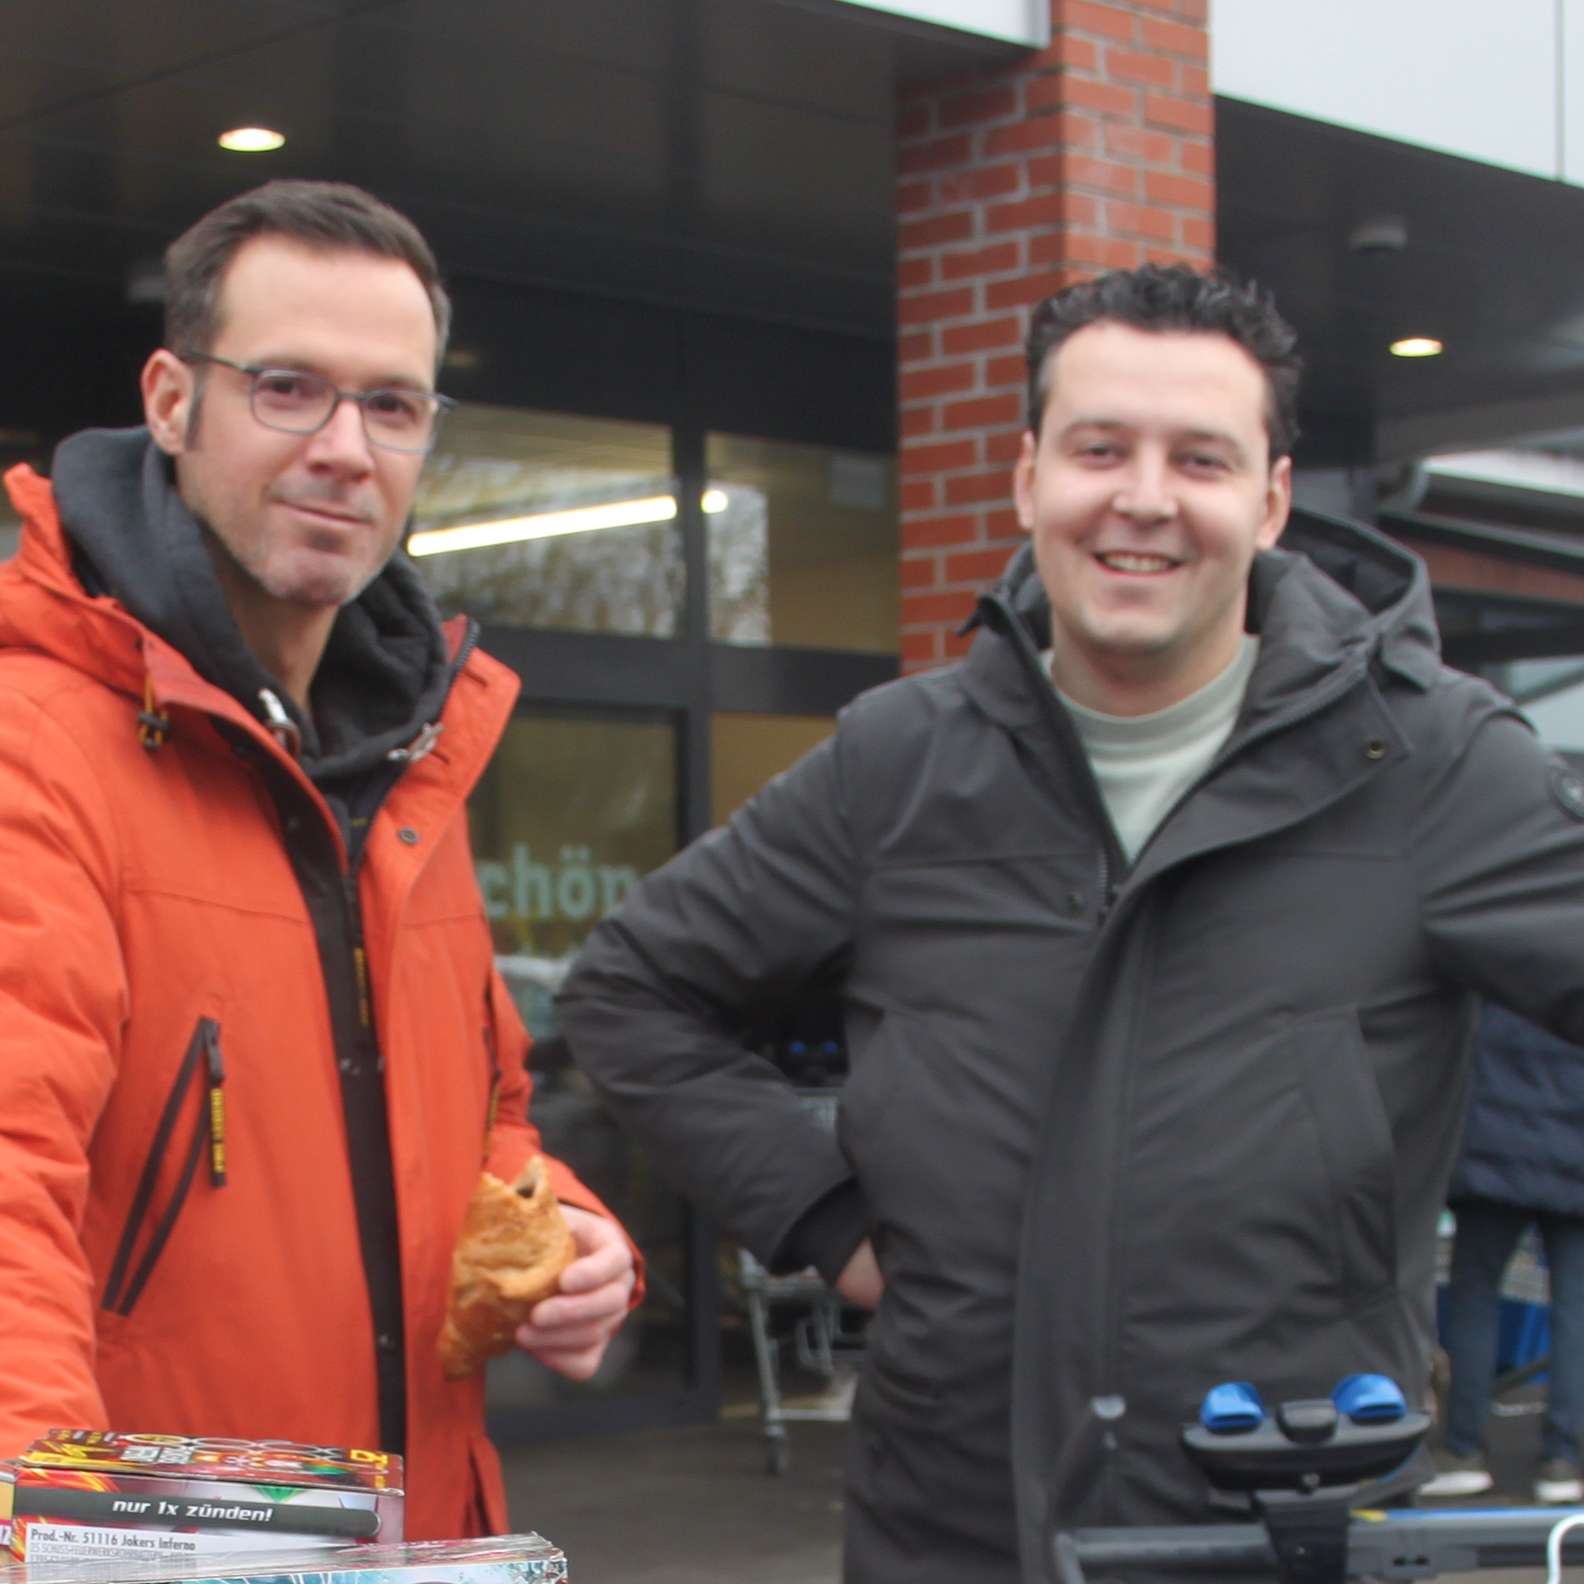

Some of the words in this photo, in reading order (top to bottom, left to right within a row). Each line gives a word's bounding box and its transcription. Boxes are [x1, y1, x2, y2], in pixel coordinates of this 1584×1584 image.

[479, 842, 638, 919] chön
[112, 1500, 150, 1516] nur
[157, 1500, 178, 1516] 1x
[185, 1503, 273, 1523] zünden!
[30, 1528, 78, 1542] Prod.-Nr.
[82, 1531, 118, 1544] 51116
[120, 1533, 156, 1548] Jokers
[158, 1538, 196, 1551] Inferno
